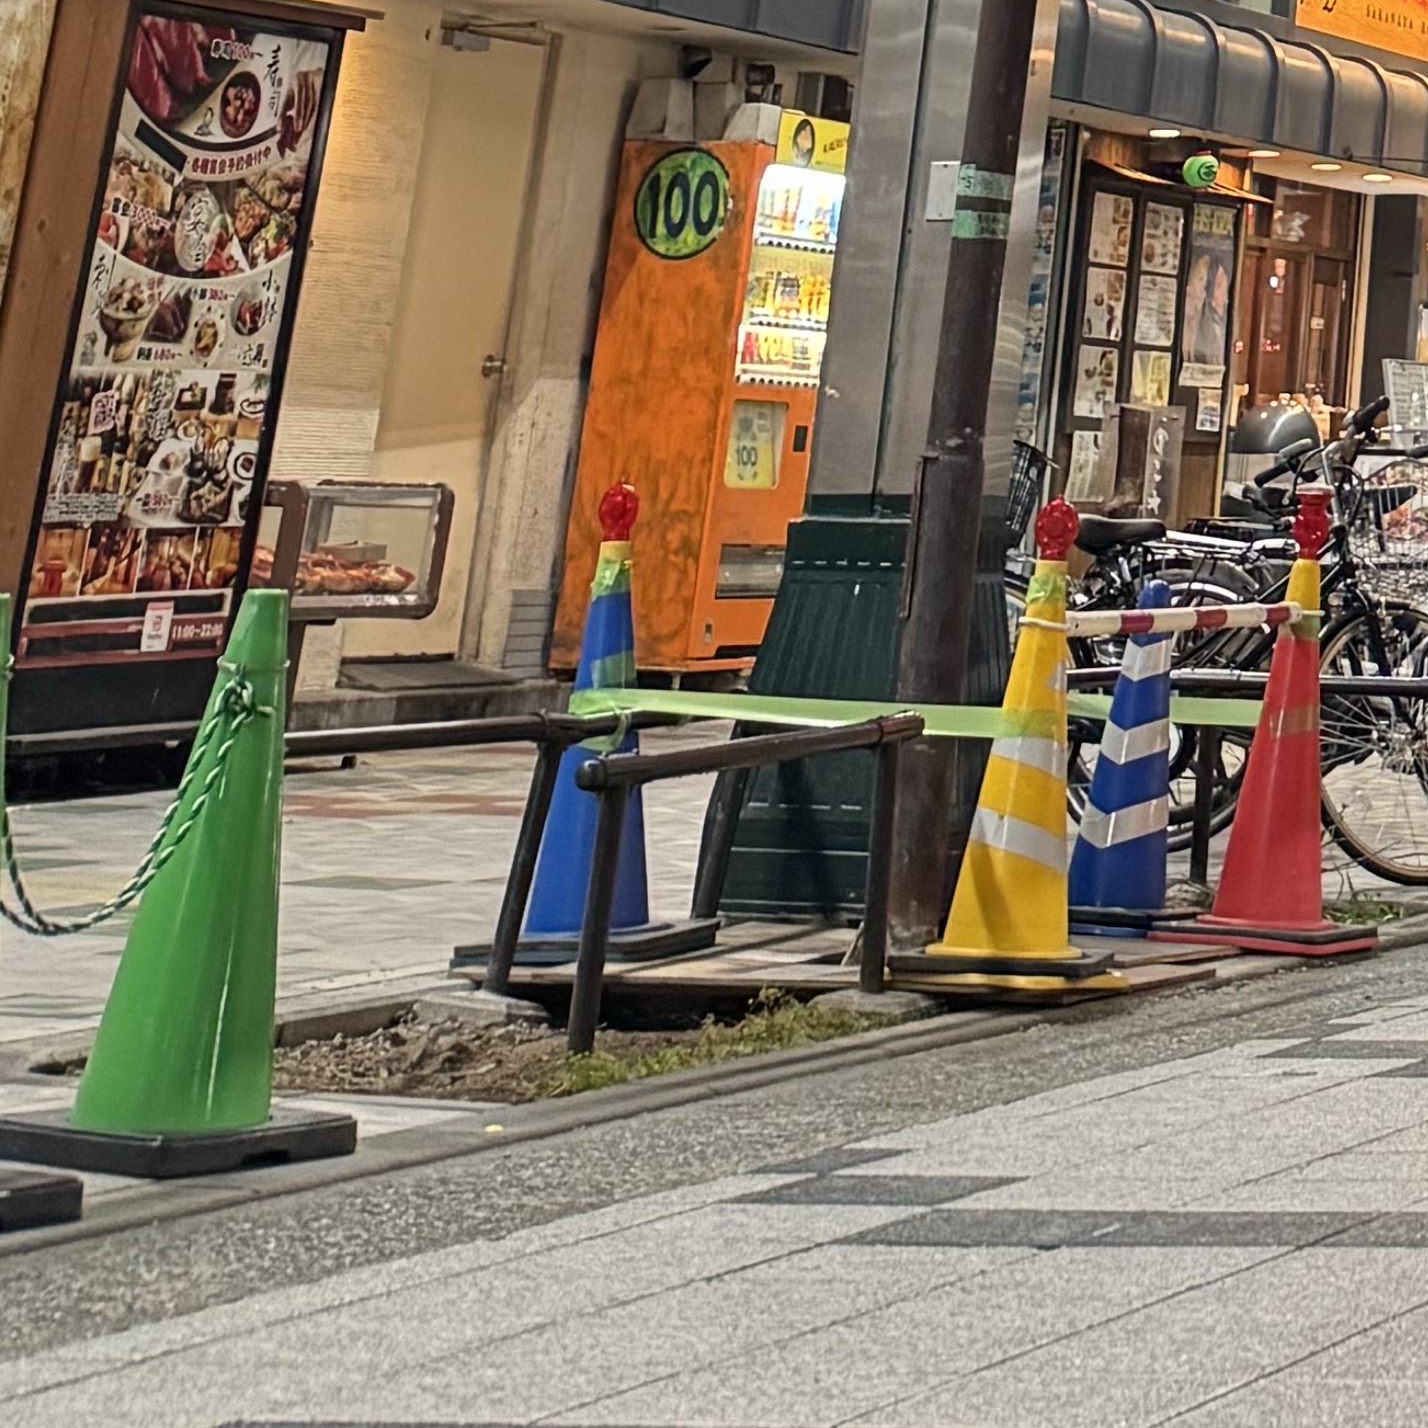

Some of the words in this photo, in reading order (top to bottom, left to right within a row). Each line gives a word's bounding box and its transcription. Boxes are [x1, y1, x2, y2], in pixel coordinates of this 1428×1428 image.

[1366, 4, 1414, 30] SAKANAYA
[646, 168, 722, 240] 100
[735, 445, 758, 467] 100
